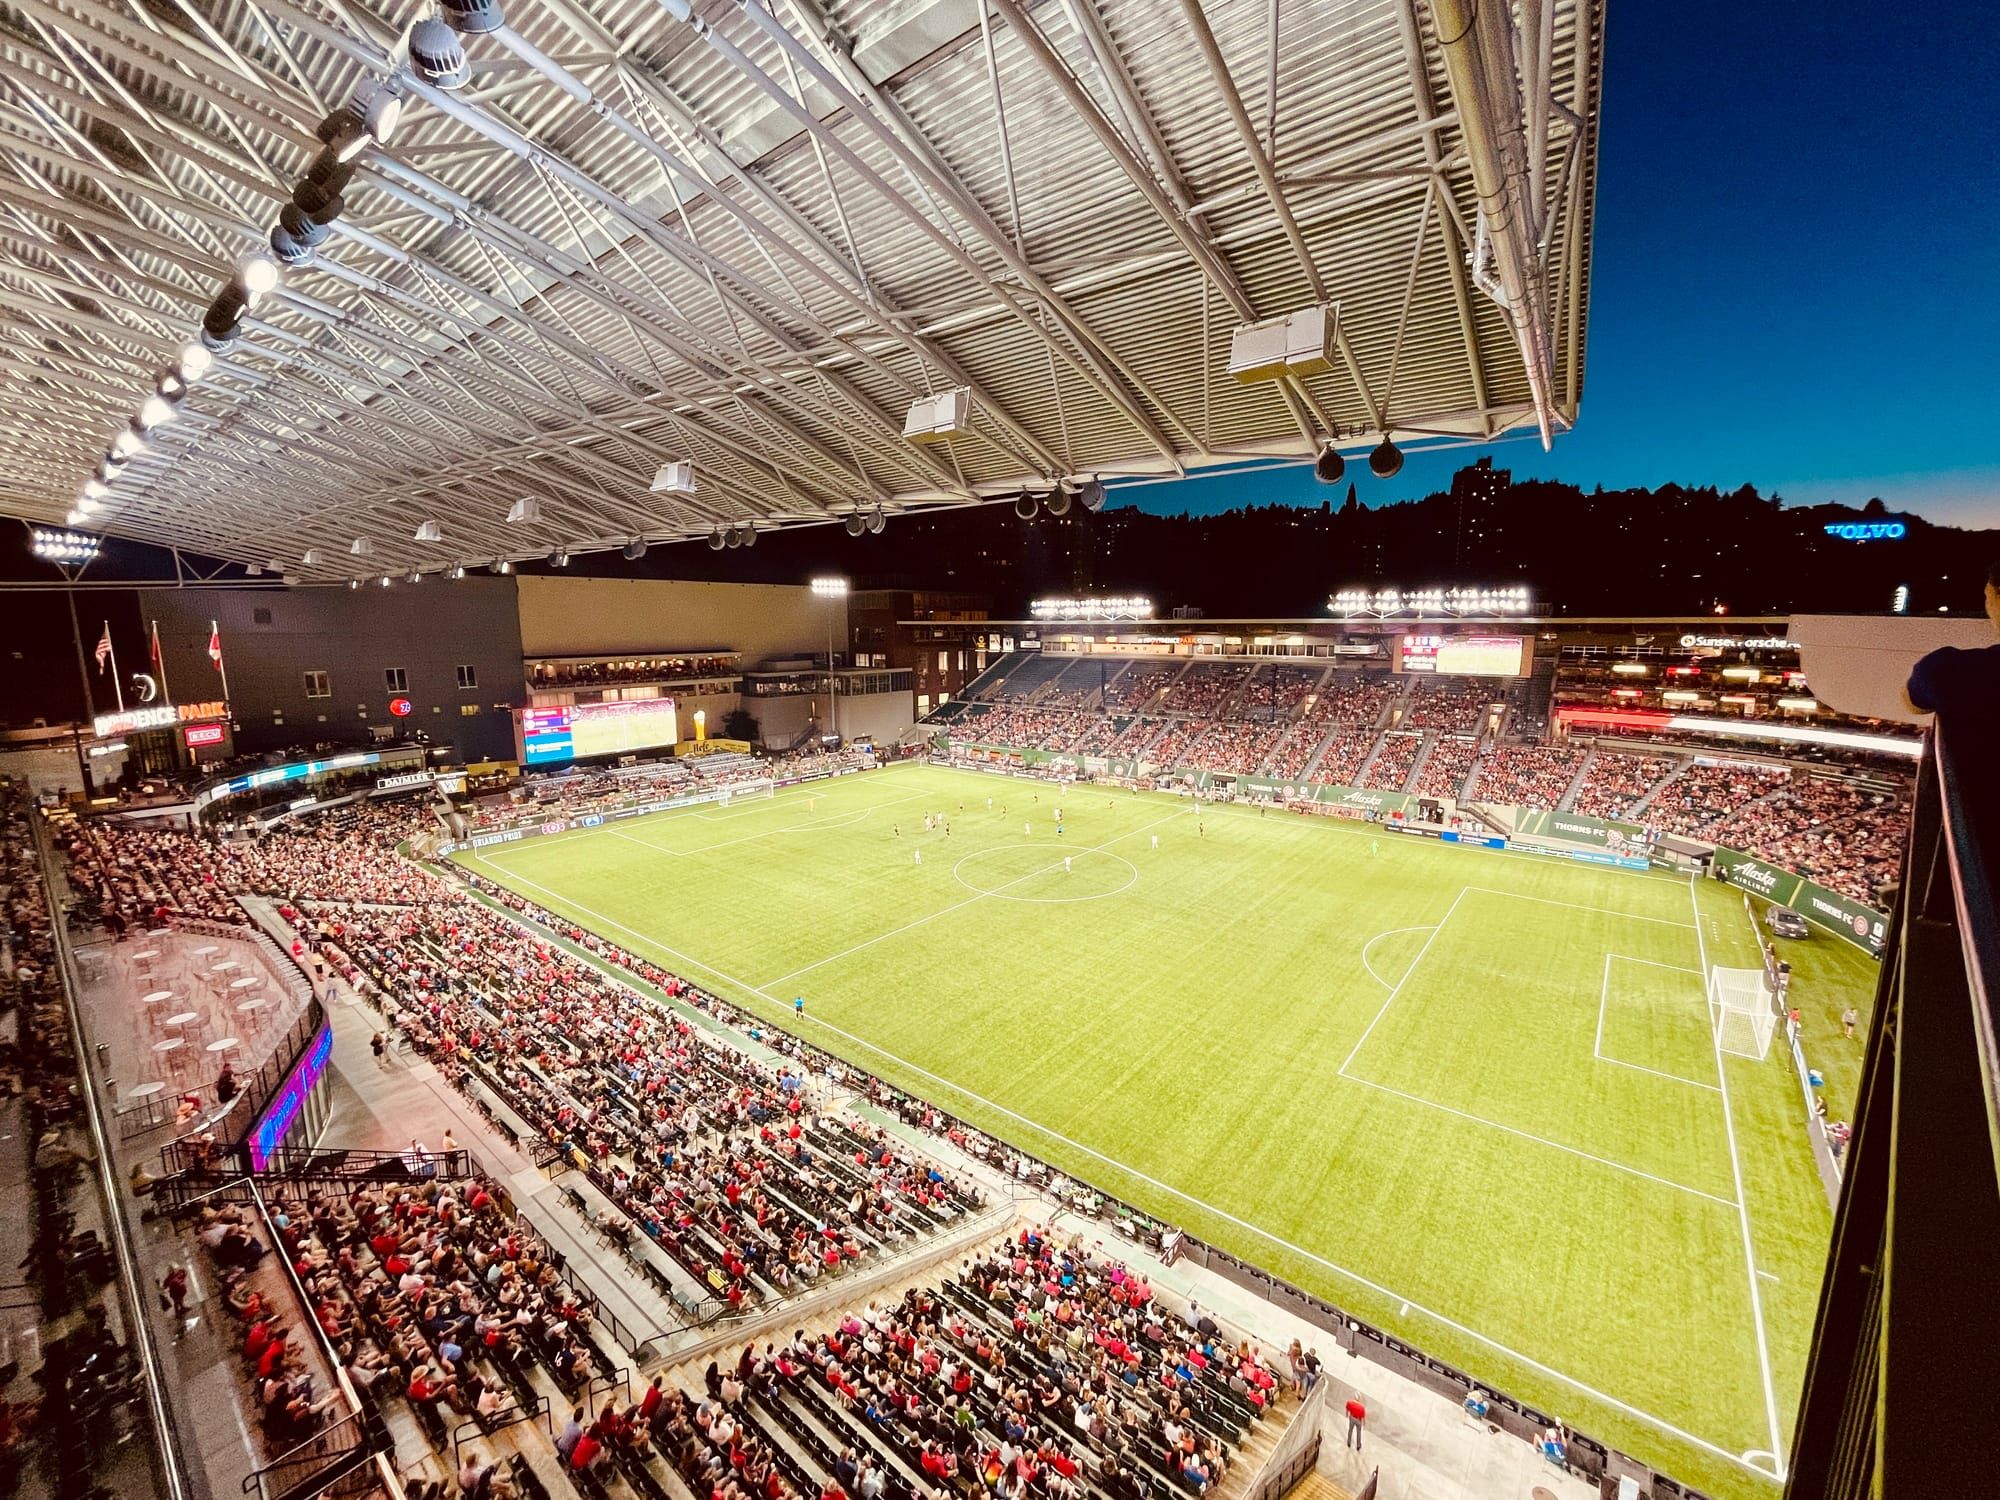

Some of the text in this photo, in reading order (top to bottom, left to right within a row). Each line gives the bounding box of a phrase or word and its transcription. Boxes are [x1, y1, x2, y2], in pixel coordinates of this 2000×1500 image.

[1823, 523, 1905, 539] VOLVO
[1737, 637, 1786, 648] orsche
[178, 701, 227, 721] PARK
[1343, 791, 1383, 806] Alaska
[1554, 822, 1606, 837] THORNS FC
[472, 835, 503, 847] ORLANDO
[503, 831, 522, 842] PRIDE
[1733, 862, 1776, 886] Alaska
[1733, 875, 1770, 894] AIRLINES
[1812, 897, 1854, 925] THORNS FC
